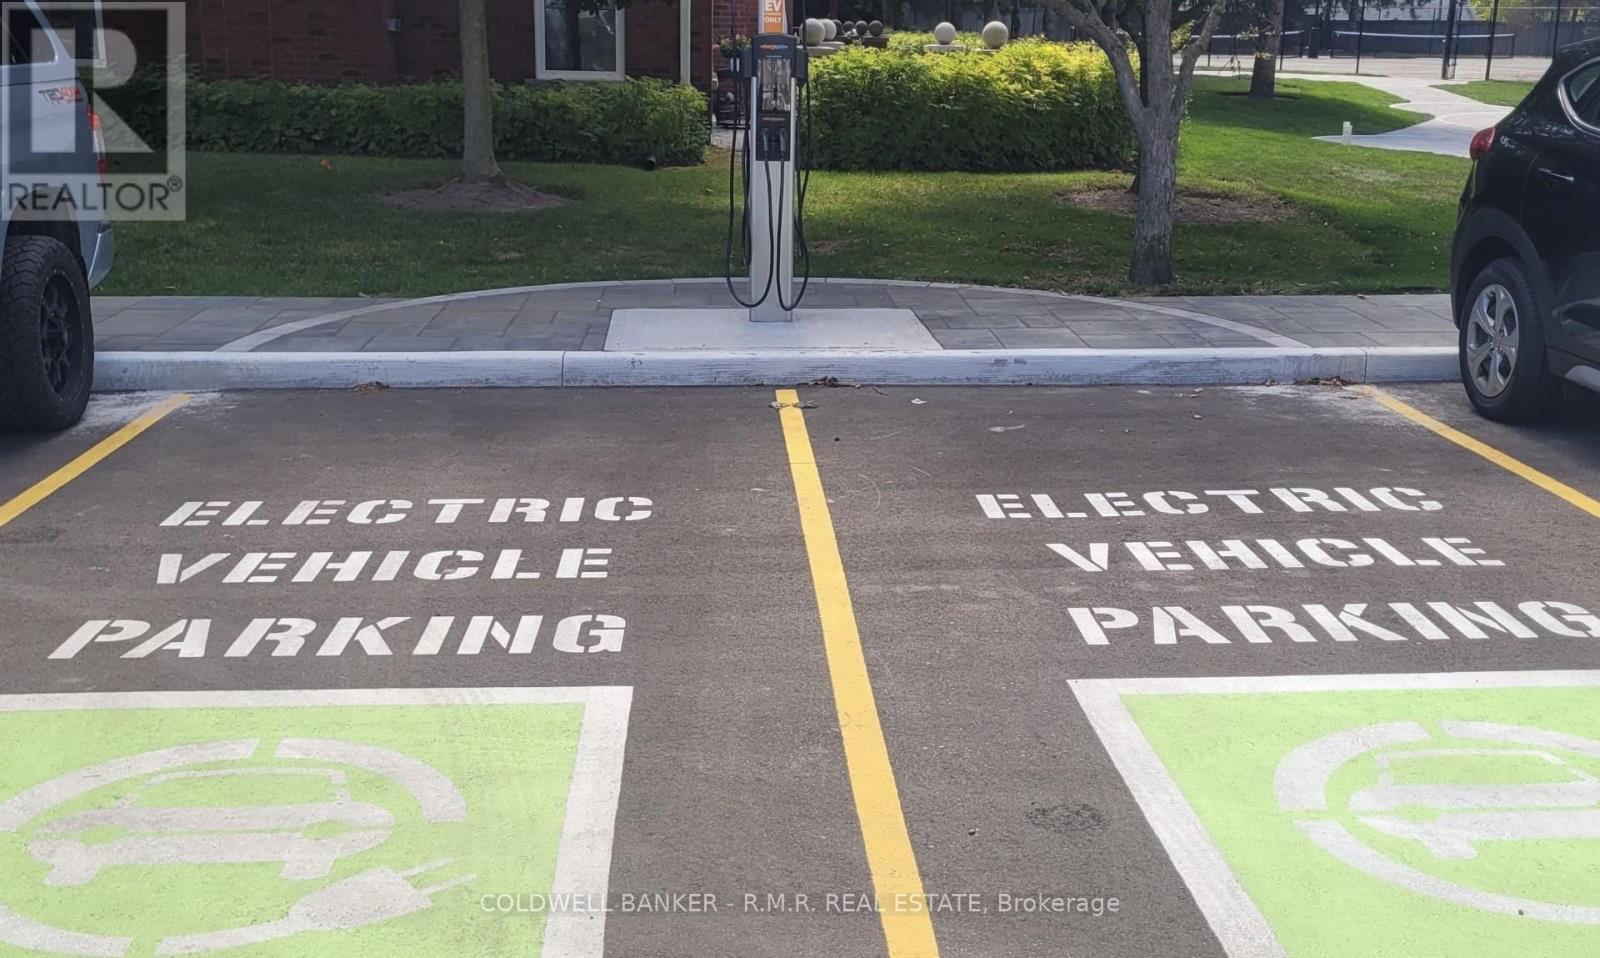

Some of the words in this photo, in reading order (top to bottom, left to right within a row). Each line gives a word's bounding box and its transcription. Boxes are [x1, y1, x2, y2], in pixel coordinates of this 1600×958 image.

[765, 0, 782, 11] EV
[765, 16, 781, 24] ONLY
[160, 497, 652, 526] ELECTRIC
[976, 487, 1443, 518] ELECTRIC
[157, 549, 612, 584] VEHICLE
[1046, 538, 1505, 571] VEHICLE
[48, 615, 625, 659] PARKING
[1068, 601, 1600, 645] PARKING
